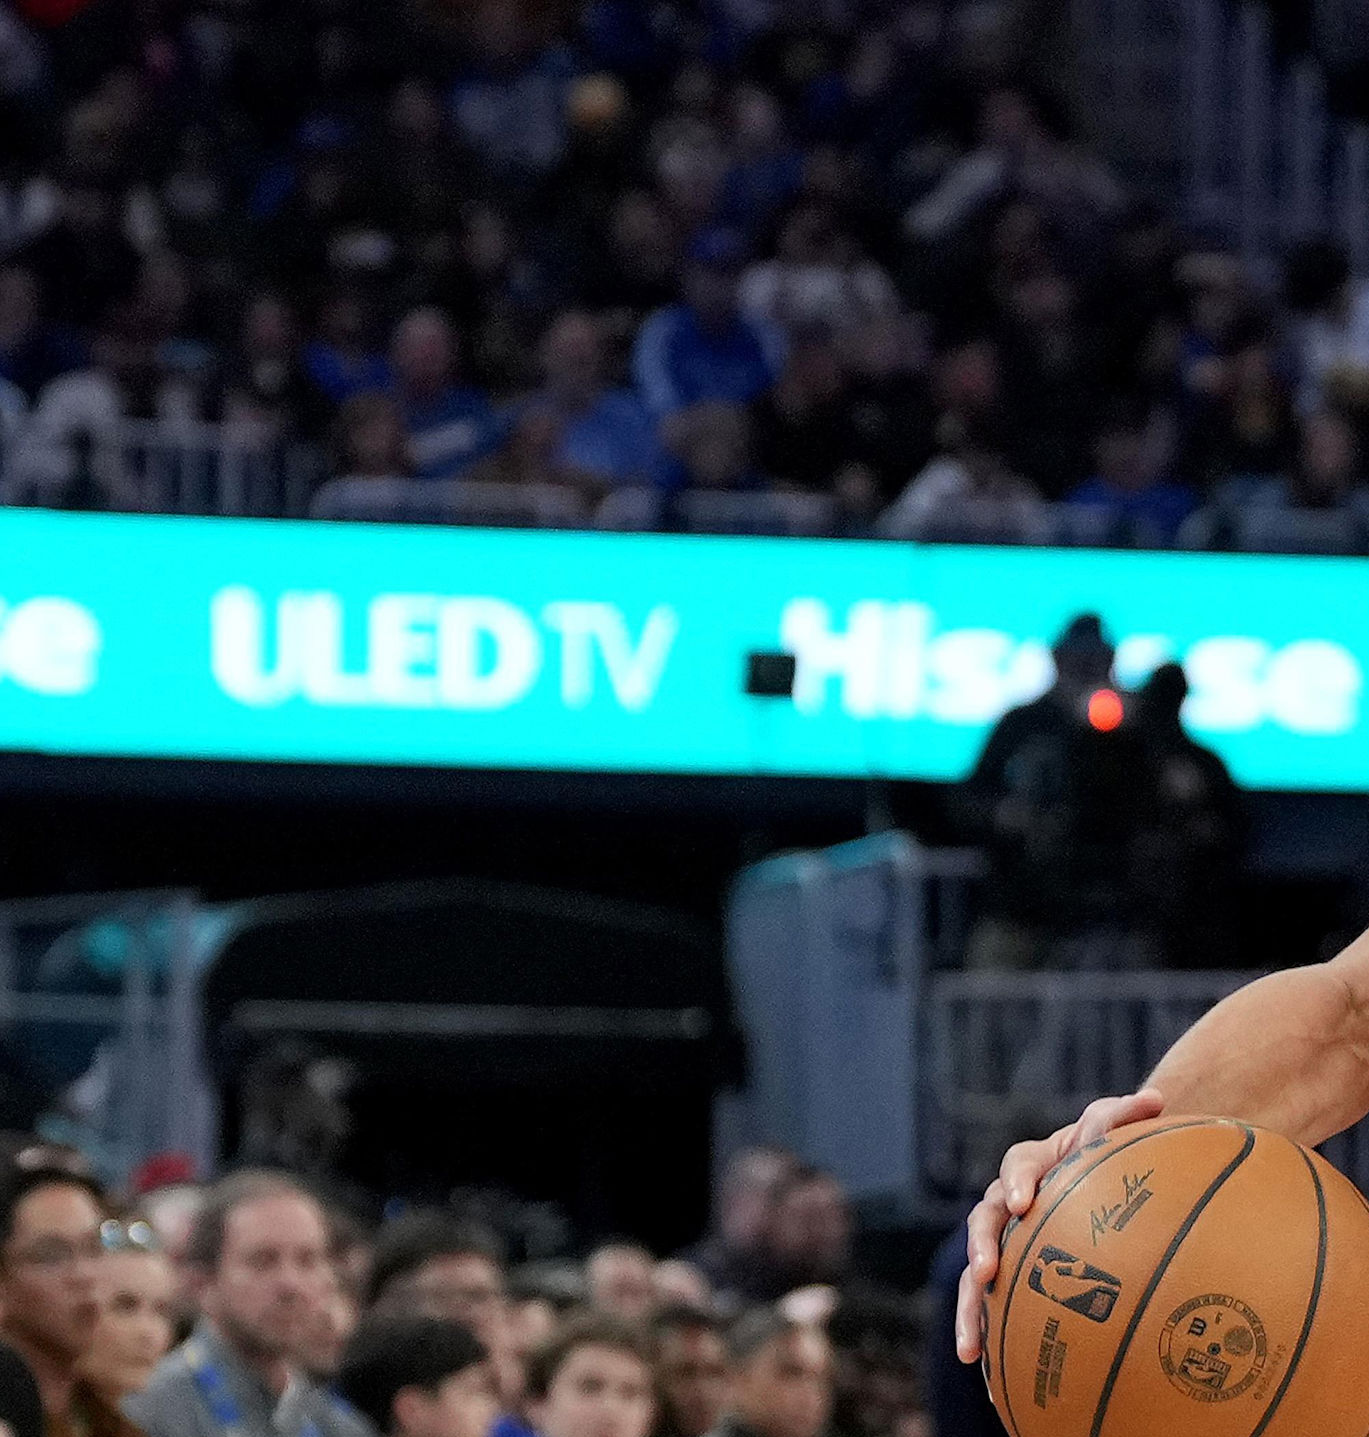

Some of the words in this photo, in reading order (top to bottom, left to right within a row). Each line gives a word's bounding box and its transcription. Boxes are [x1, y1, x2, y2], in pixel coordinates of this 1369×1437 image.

[0, 595, 102, 697] e
[211, 584, 542, 709] ULED
[542, 600, 681, 712] TV
[781, 598, 1363, 735] Hisse
